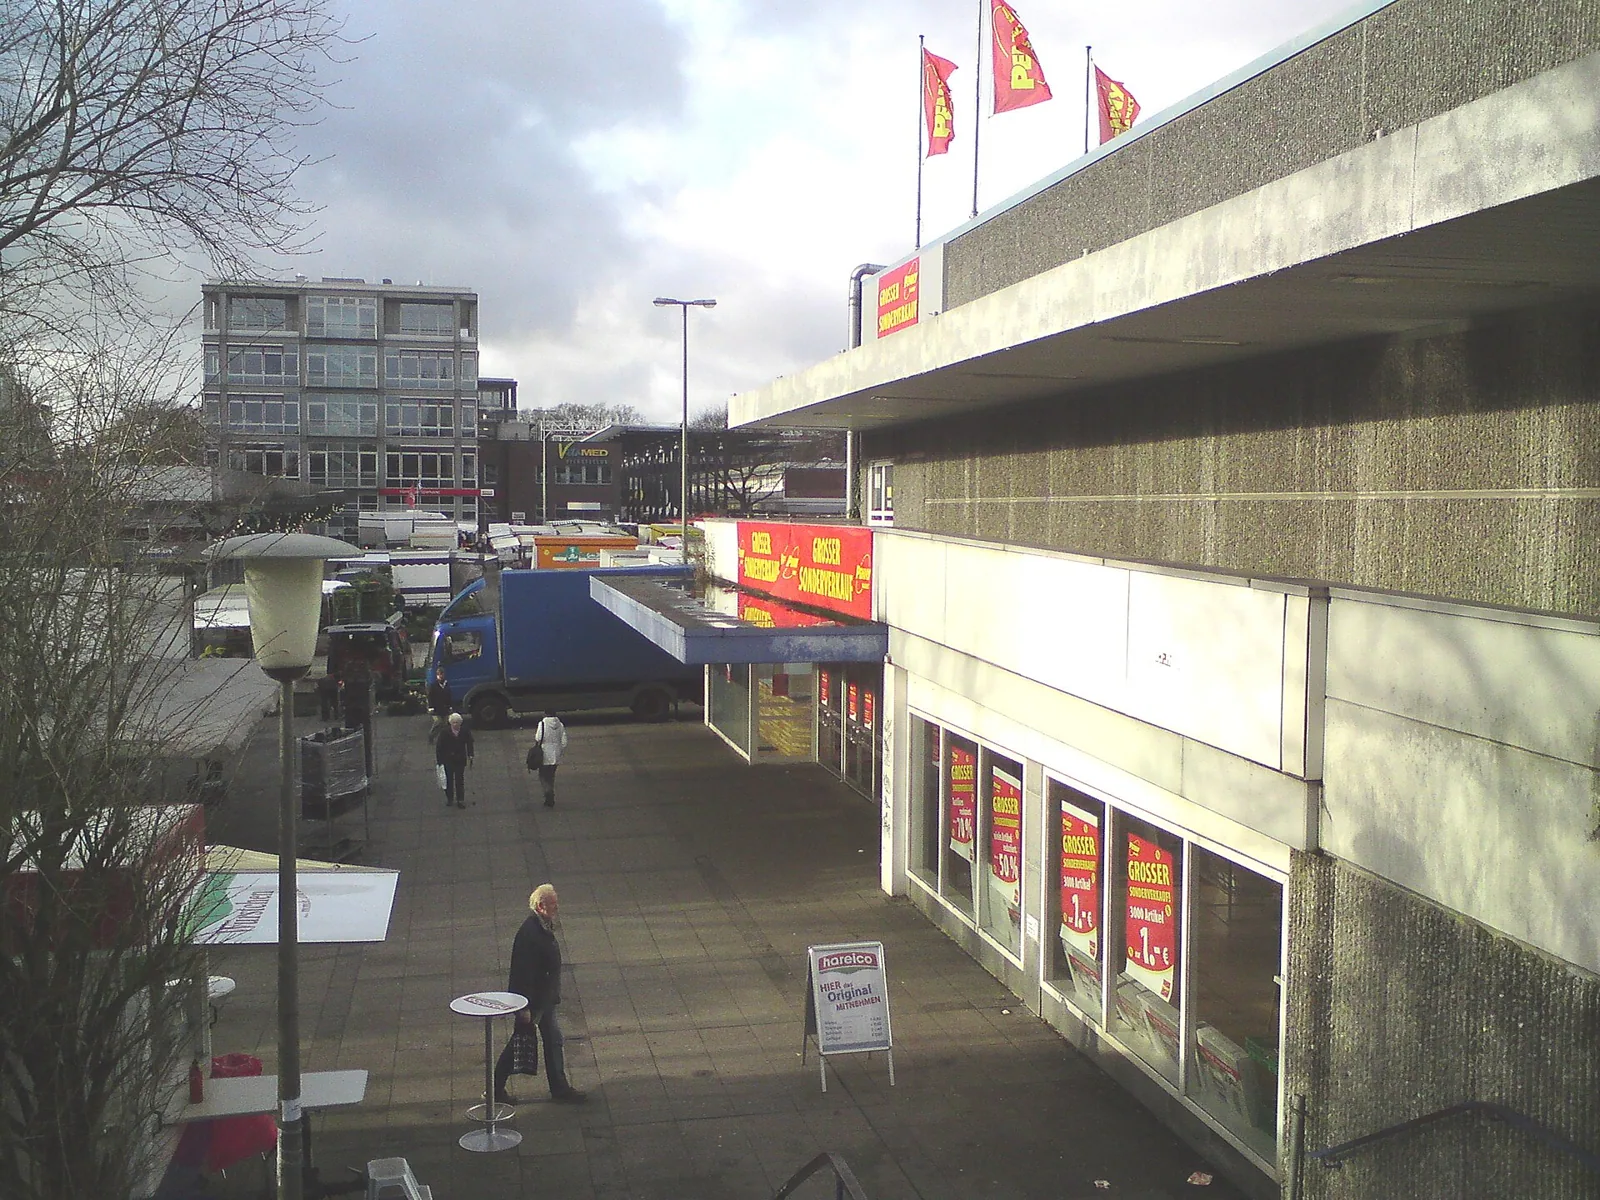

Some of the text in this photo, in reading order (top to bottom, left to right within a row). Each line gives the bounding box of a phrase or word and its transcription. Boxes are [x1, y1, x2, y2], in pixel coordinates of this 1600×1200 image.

[812, 537, 841, 565] GROSSER
[951, 764, 974, 780] GROSSER
[993, 796, 1019, 815] GROSSER
[1063, 834, 1096, 856] GROSSER
[1128, 859, 1171, 886] GROSSER
[1130, 905, 1164, 924] 3000 Artikel
[823, 952, 873, 968] hareico
[820, 980, 841, 992] HIER
[827, 983, 872, 1002] Original
[836, 995, 881, 1011] MITNEHMEN
